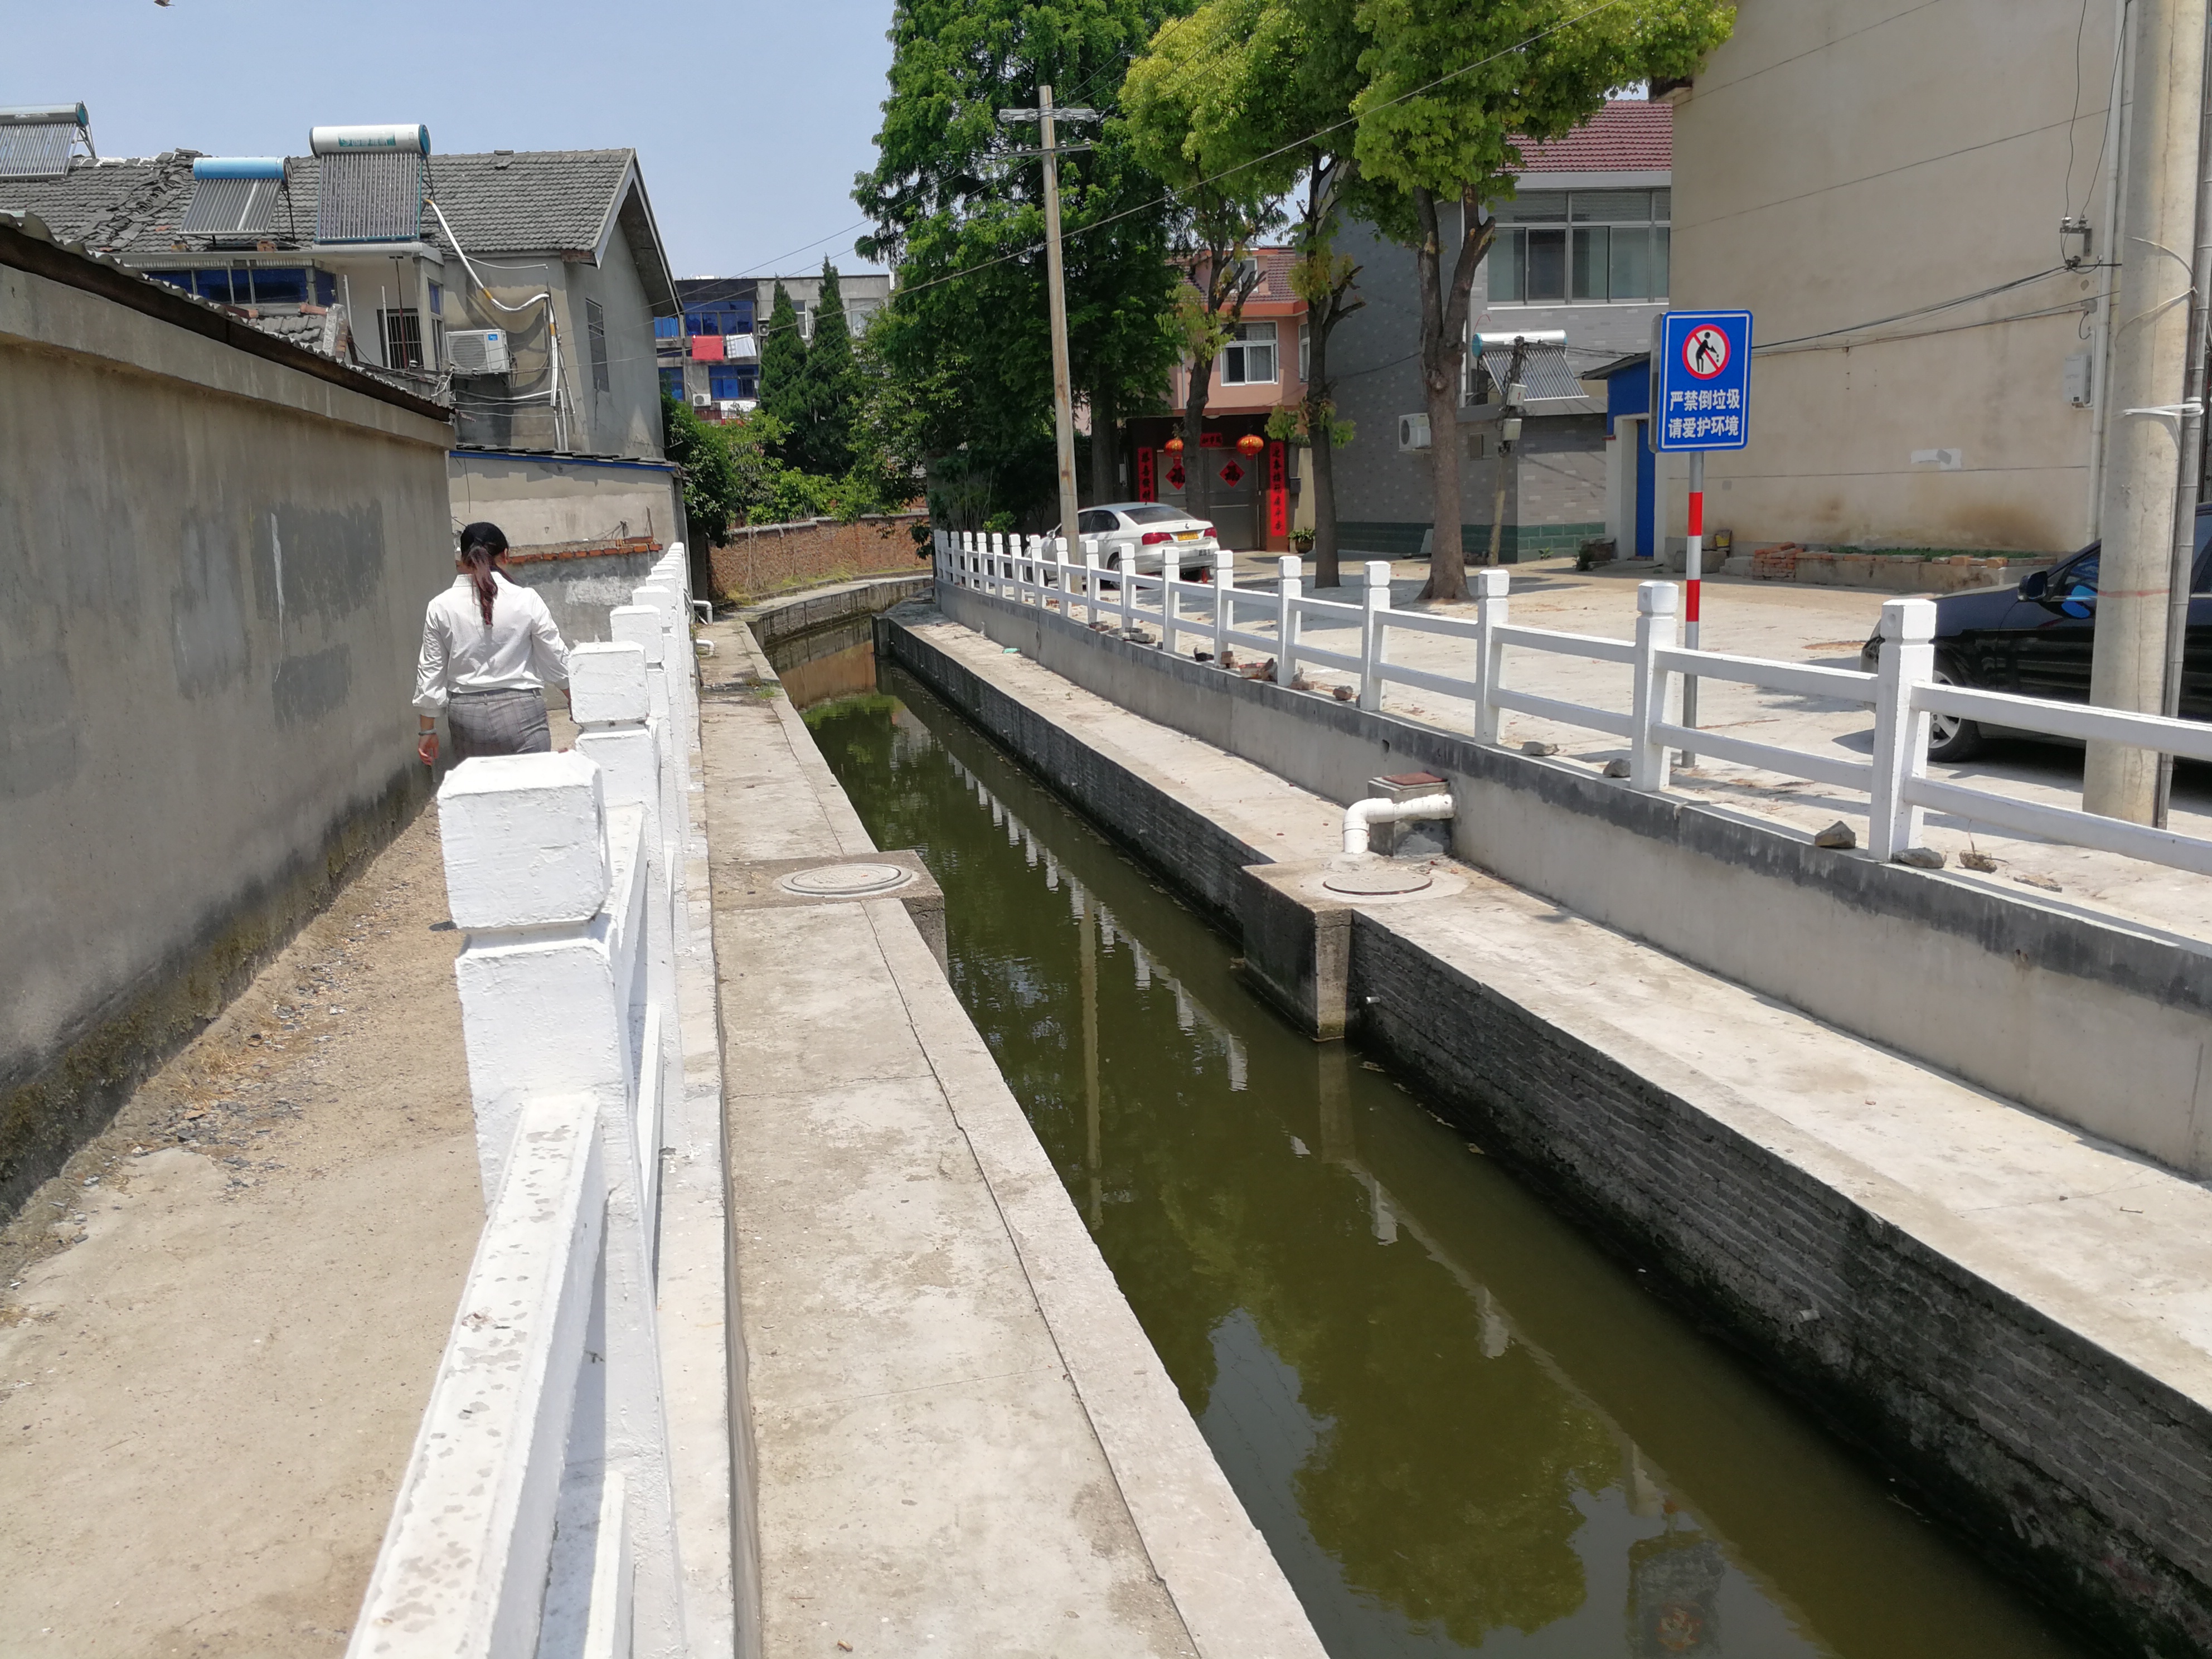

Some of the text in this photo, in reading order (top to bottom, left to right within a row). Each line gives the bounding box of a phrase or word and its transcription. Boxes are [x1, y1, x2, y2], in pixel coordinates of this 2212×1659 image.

[1670, 389, 1740, 411] 严禁倒垃圾
[1668, 415, 1739, 439] 请爱护环境
